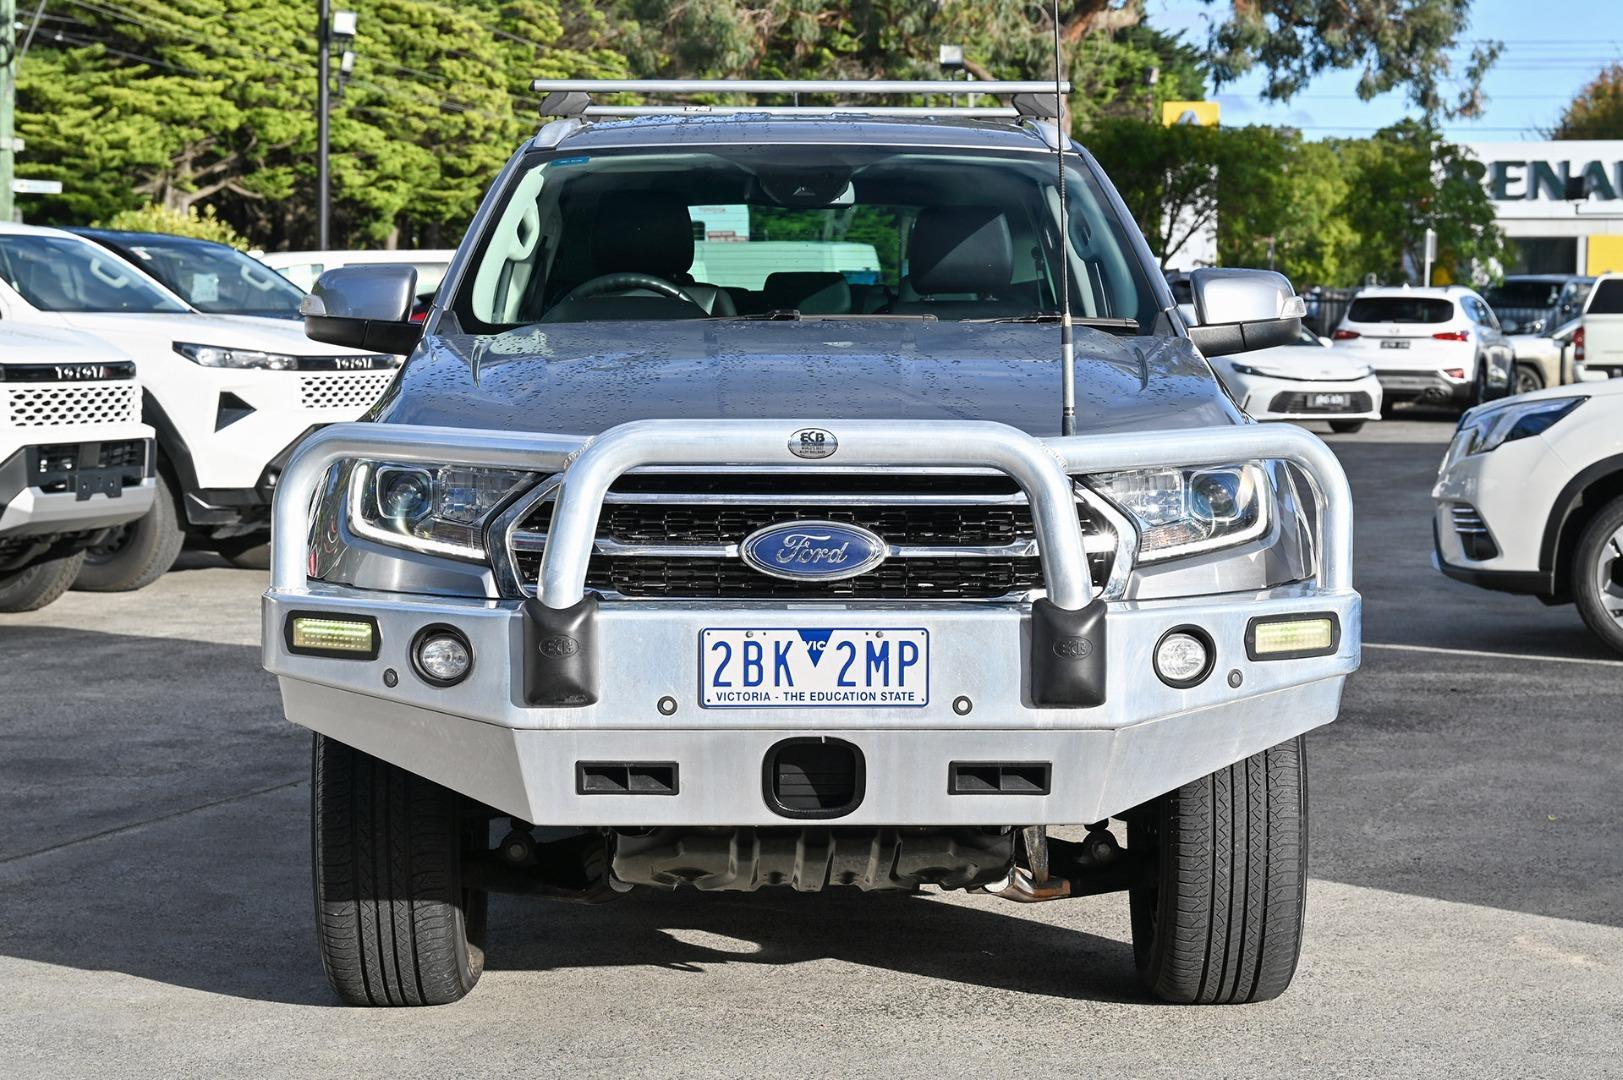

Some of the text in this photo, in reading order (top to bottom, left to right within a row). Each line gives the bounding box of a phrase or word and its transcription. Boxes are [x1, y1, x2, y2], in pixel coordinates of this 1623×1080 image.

[800, 431, 825, 443] ECB
[776, 533, 850, 564] Ford
[803, 640, 827, 651] VIC
[711, 640, 919, 688] 2BK 2MP
[715, 691, 771, 702] VICTORIA
[784, 691, 806, 702] THE
[809, 691, 876, 702] EDUCATION
[880, 691, 915, 702] STATE
